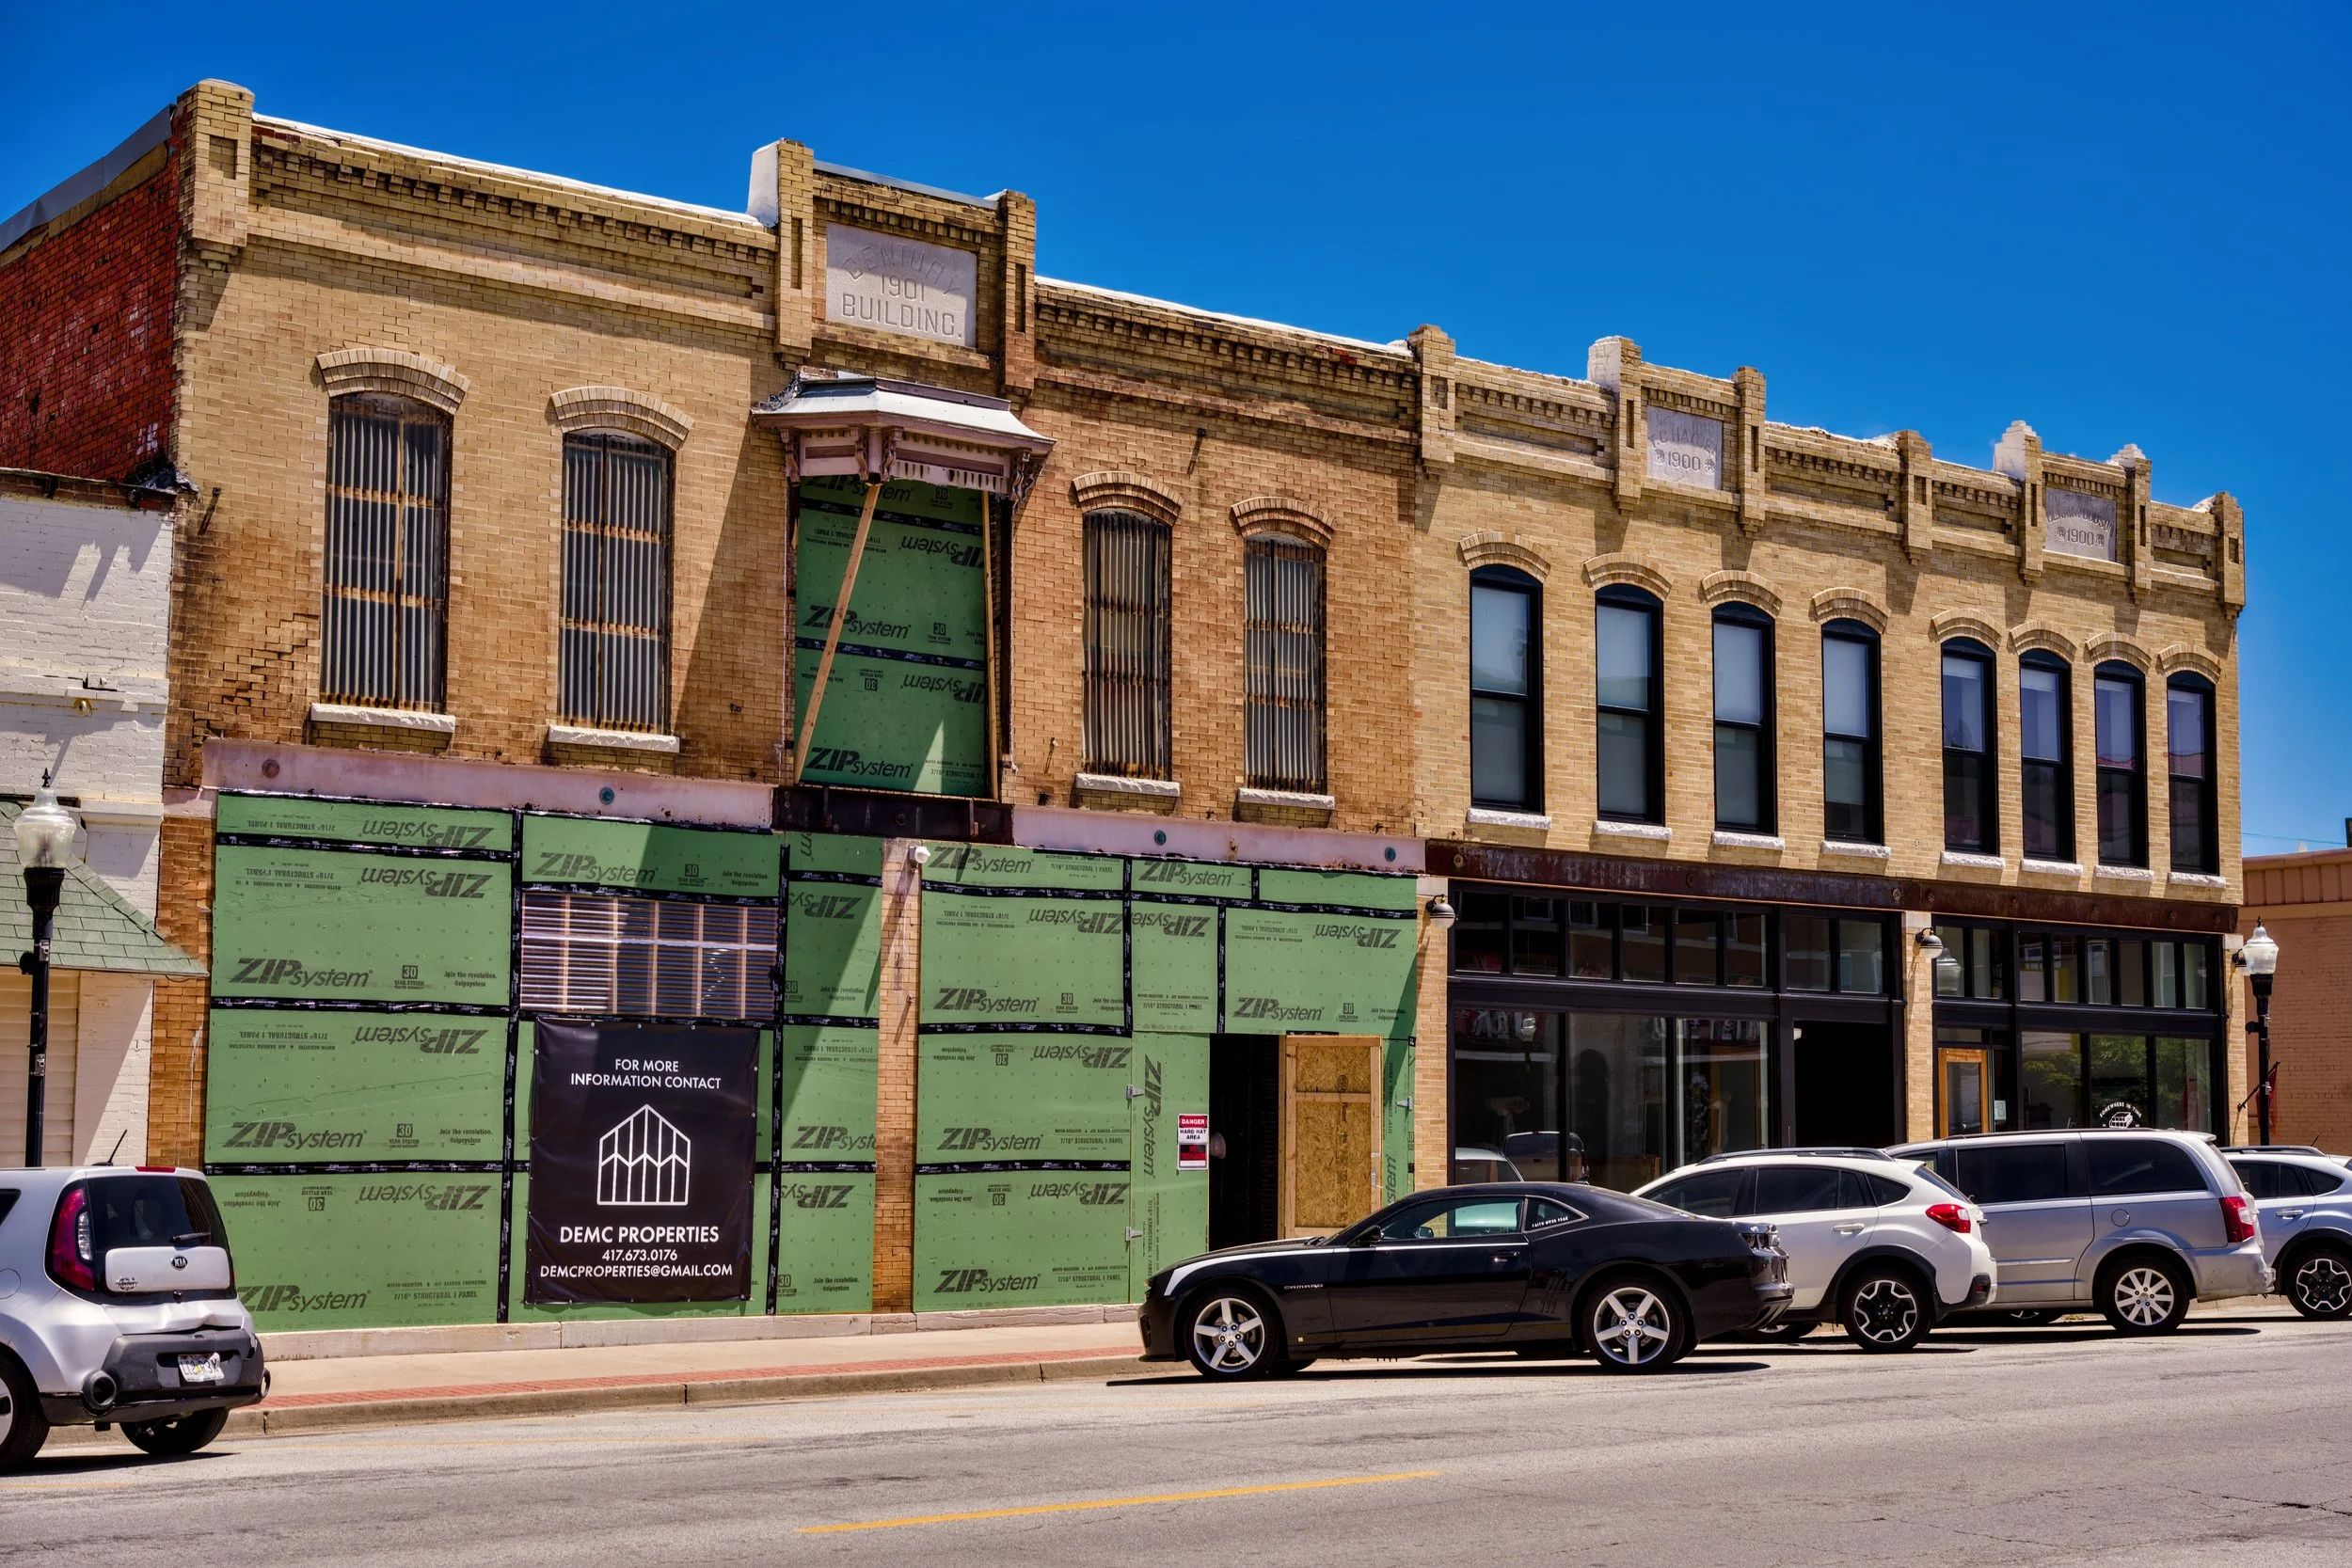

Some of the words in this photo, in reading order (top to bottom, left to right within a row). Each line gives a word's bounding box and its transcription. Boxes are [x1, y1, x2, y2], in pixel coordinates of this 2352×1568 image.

[881, 273, 925, 302] 1901
[841, 293, 962, 338] BUILDING.
[1668, 451, 1701, 471] 1900
[2067, 529, 2094, 546] 1900
[615, 1058, 639, 1072] FOR
[643, 1059, 678, 1072] MORE
[570, 1073, 662, 1088] INFORMATION
[665, 1076, 722, 1089] CONTACT
[398, 1124, 412, 1136] 30
[309, 1197, 324, 1211] 30
[560, 1226, 613, 1243] DEMC
[618, 1226, 720, 1243] PROPERTIES
[175, 1258, 192, 1267] KIA
[602, 1249, 677, 1261] 417.673.0176
[540, 1263, 733, 1278] DEMCPROPERTIES@GMAIL.COM
